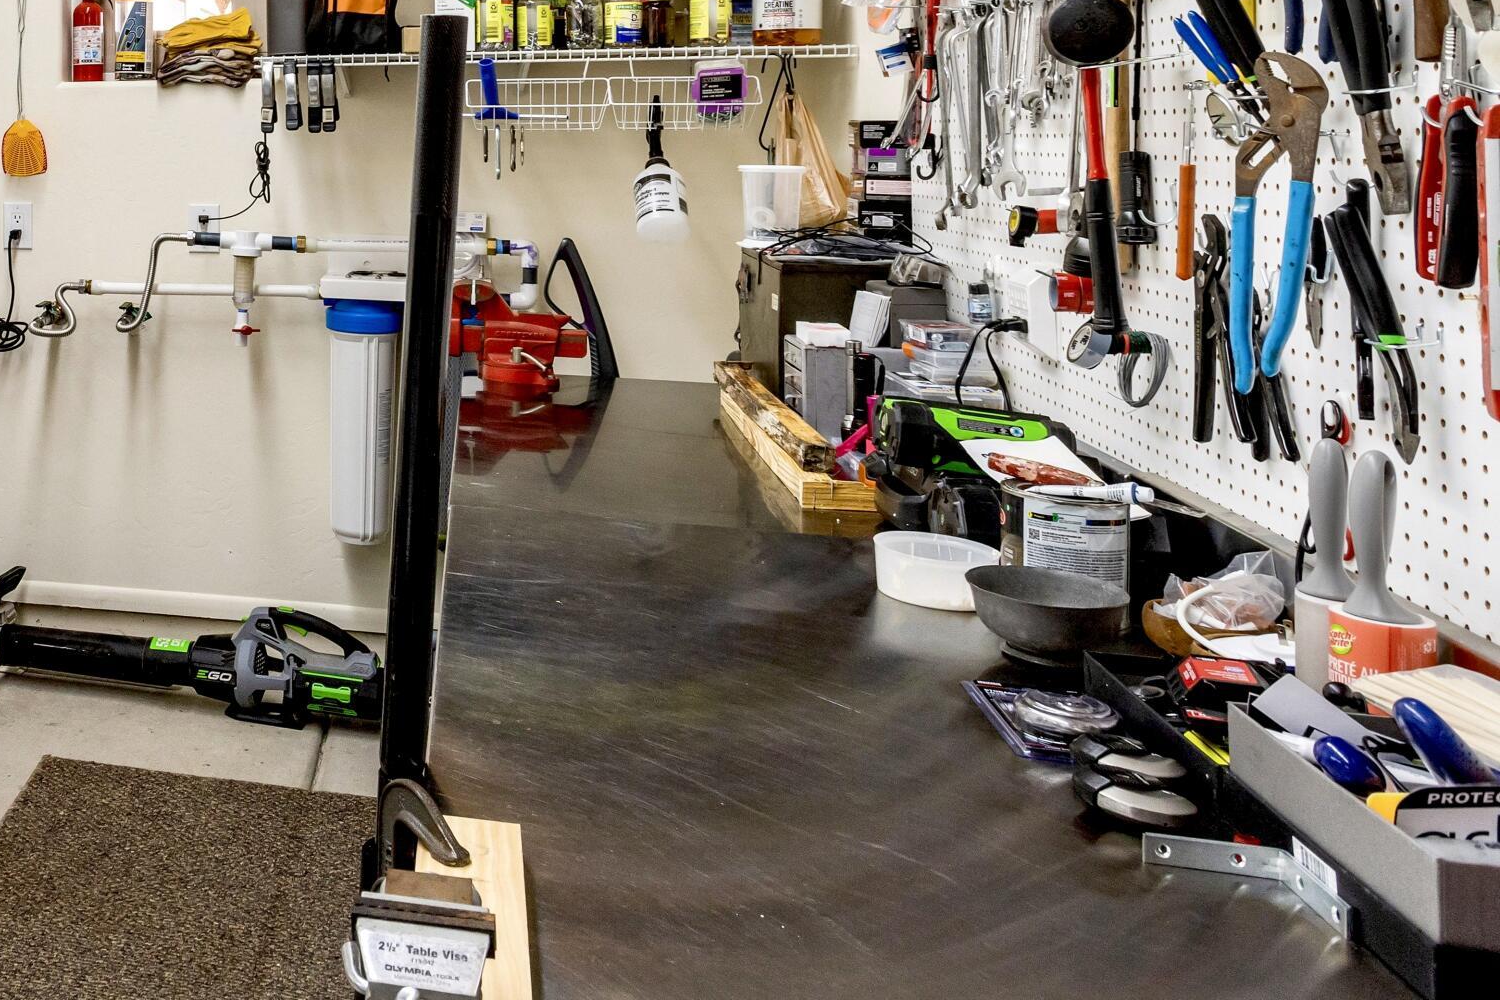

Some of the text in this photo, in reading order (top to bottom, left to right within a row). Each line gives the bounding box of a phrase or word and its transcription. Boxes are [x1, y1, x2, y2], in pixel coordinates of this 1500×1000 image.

[764, 0, 793, 8] CREATINE
[1330, 630, 1351, 641] cotch
[196, 669, 233, 681] EGO
[405, 945, 438, 958] Table
[384, 963, 432, 977] OLYMPIA
